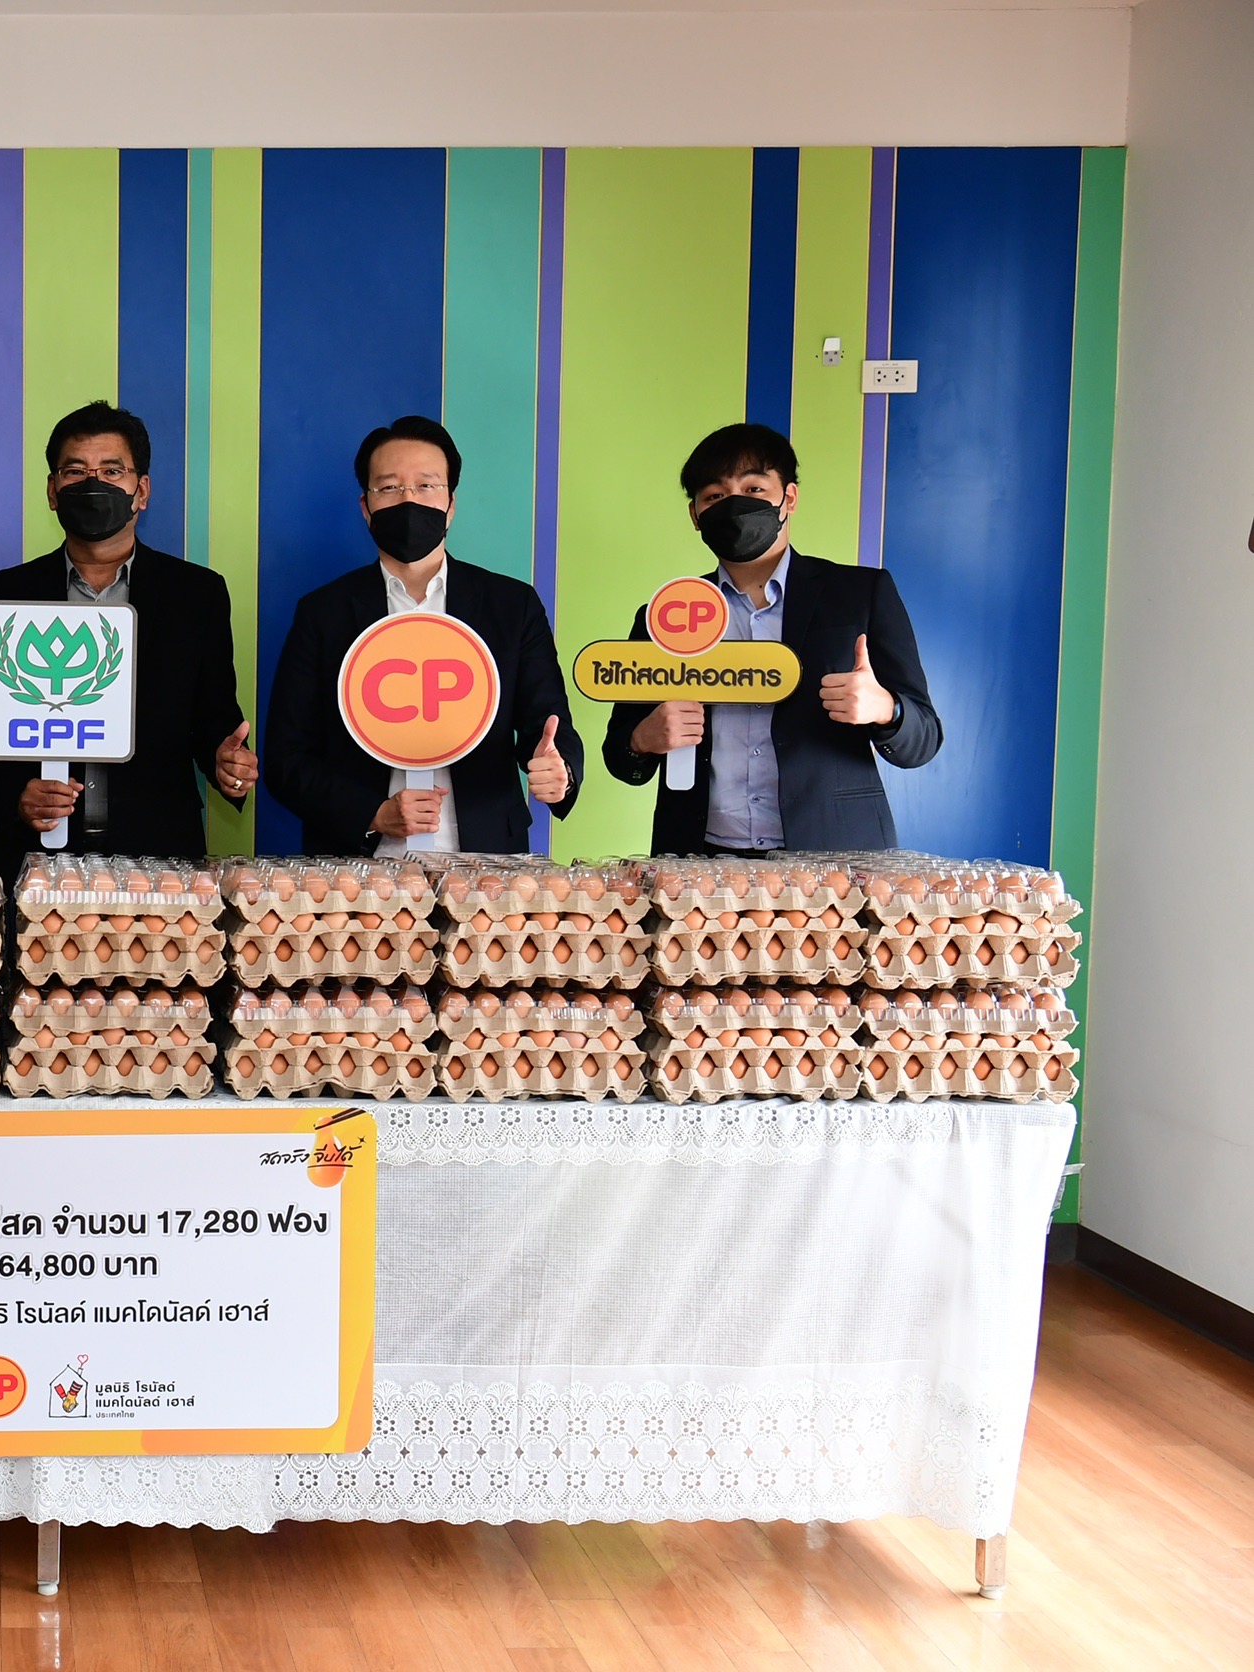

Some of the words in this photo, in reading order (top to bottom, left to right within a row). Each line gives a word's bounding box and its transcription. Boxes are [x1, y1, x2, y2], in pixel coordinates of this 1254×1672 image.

[657, 600, 717, 633] CP
[592, 660, 782, 687] ไข่ไก่สดปลอดสาร
[361, 658, 474, 723] CP
[8, 718, 105, 750] CPF
[259, 1149, 310, 1166] สดจริง
[51, 1205, 146, 1235] จำนวน
[157, 1210, 258, 1239] 17,280
[268, 1204, 327, 1233] ฟอง
[104, 1255, 158, 1276] บาท
[15, 1300, 86, 1324] โรนัลด์
[94, 1299, 211, 1322] แมคโดนัลด์
[218, 1298, 269, 1321] เฮาส์
[95, 1382, 130, 1396] มูลนิธิ
[136, 1381, 176, 1393] โรนัลด์
[95, 1395, 161, 1408] แมคโดนัลด์
[166, 1396, 195, 1407] เฮาส์
[95, 1411, 135, 1419] ประเทศไทย
